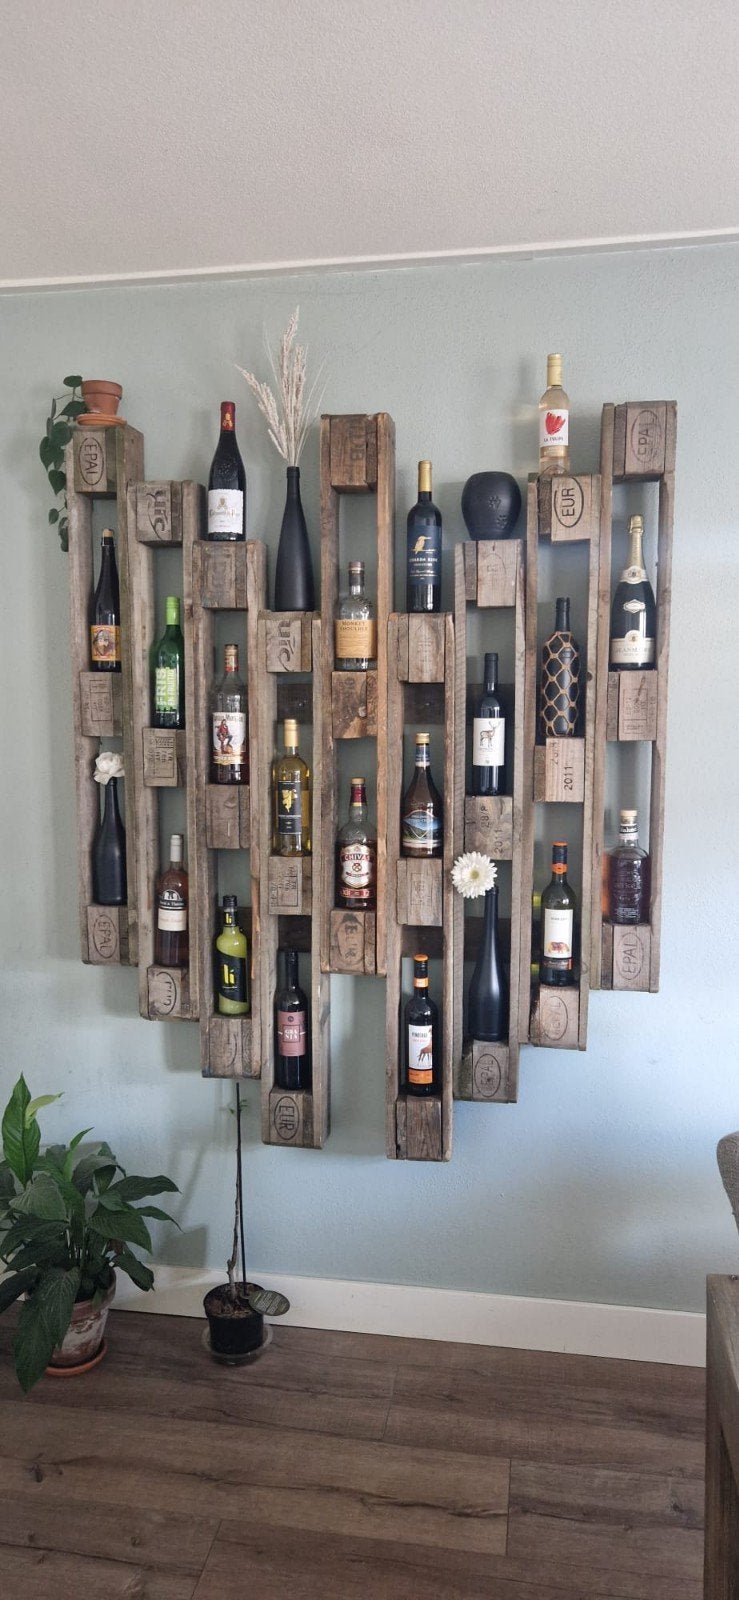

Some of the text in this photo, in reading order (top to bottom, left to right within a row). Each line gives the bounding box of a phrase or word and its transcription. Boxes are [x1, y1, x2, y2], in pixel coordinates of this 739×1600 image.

[561, 487, 576, 517] EUR
[563, 766, 573, 791] 2011
[622, 941, 637, 975] EPAL
[278, 1104, 295, 1131] EUR
